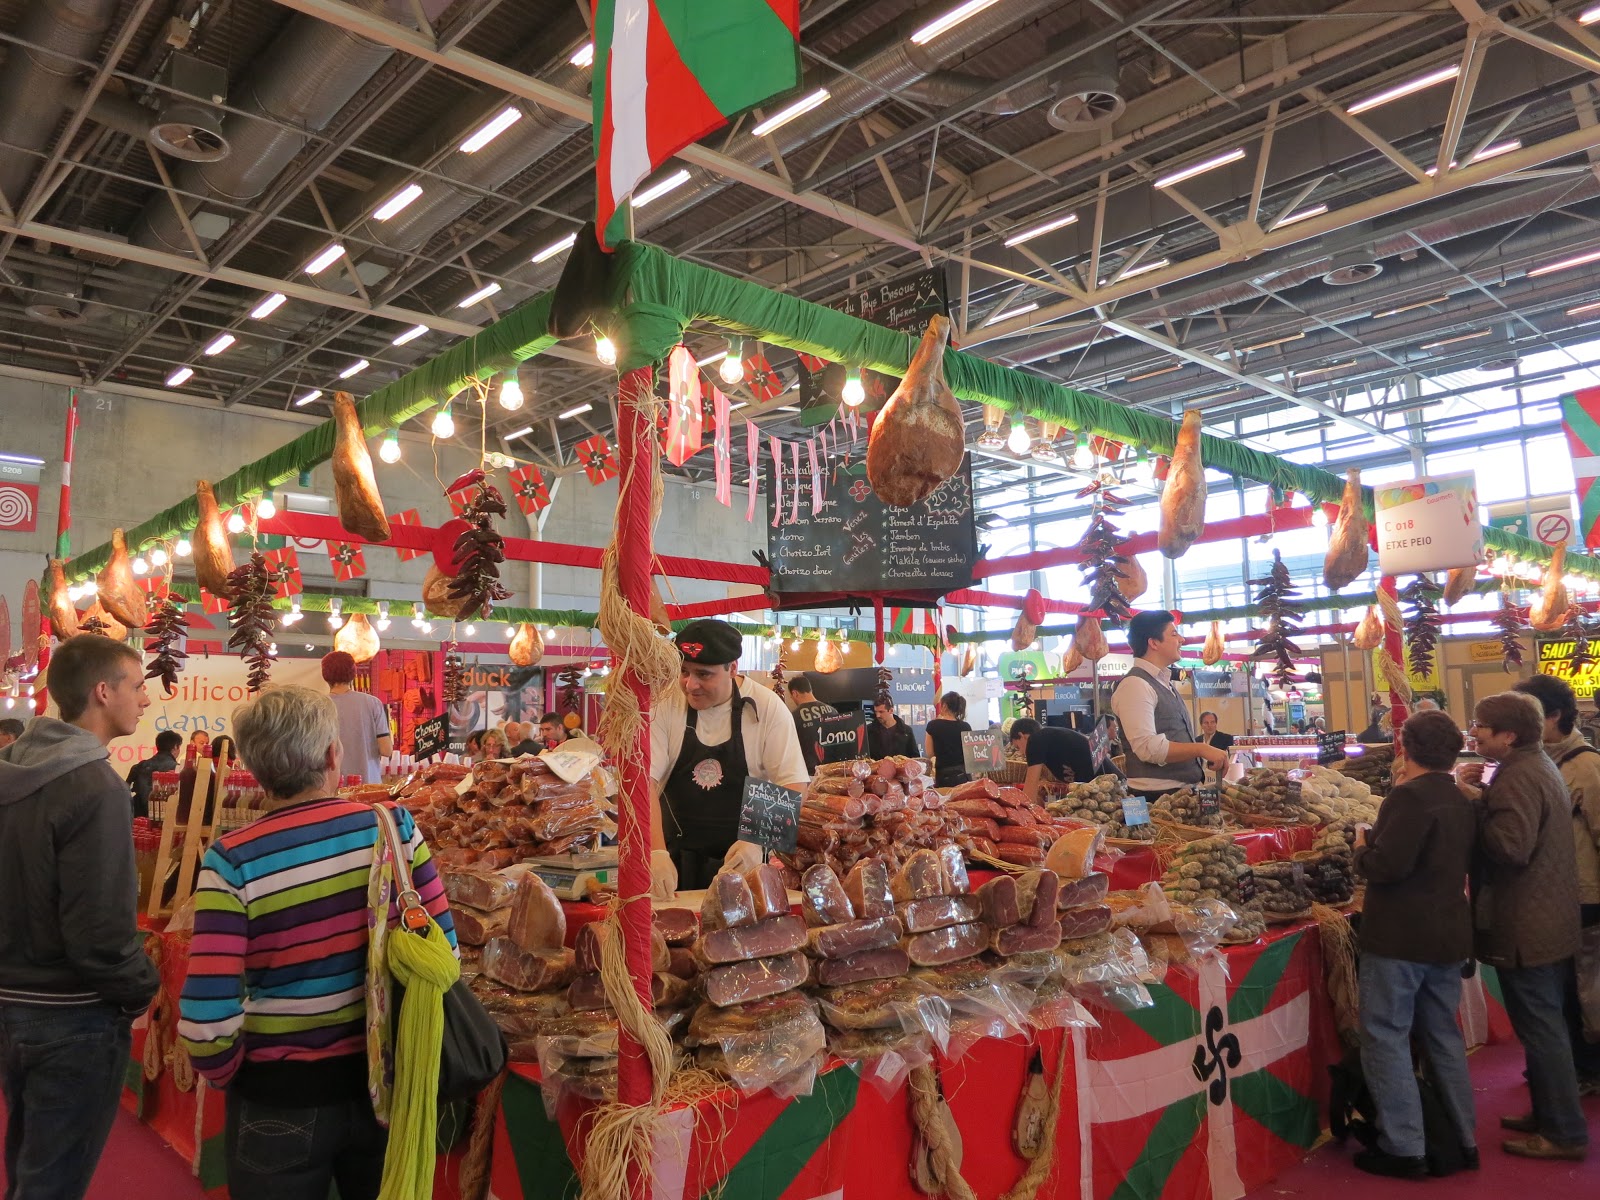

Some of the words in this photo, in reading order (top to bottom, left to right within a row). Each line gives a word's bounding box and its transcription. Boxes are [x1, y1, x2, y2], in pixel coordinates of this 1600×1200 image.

[844, 297, 855, 314] du
[95, 398, 112, 411] 21
[2, 466, 23, 475] 5208
[690, 490, 701, 500] 18
[1426, 493, 1454, 505] Gourmets
[842, 511, 868, 531] Venez
[888, 515, 916, 527] Piment
[1384, 521, 1392, 532] C
[1395, 519, 1415, 531] 018
[779, 528, 805, 541] Lomo
[889, 529, 921, 541] Jambon
[889, 541, 917, 555] Fromage
[919, 542, 928, 552] de
[930, 541, 951, 552] brebis
[1386, 539, 1408, 551] ETXE
[1410, 536, 1432, 547] PEIO
[779, 545, 813, 557] Chorizo
[888, 554, 921, 566] Makila
[778, 565, 811, 575] Chorizo
[812, 564, 833, 576] doux
[888, 567, 927, 578] Chorizettes
[461, 667, 511, 688] duck
[154, 705, 227, 733] dans
[817, 726, 856, 746] Lomo
[449, 741, 467, 752] omp
[748, 784, 777, 803] Jambon
[777, 791, 796, 811] basque
